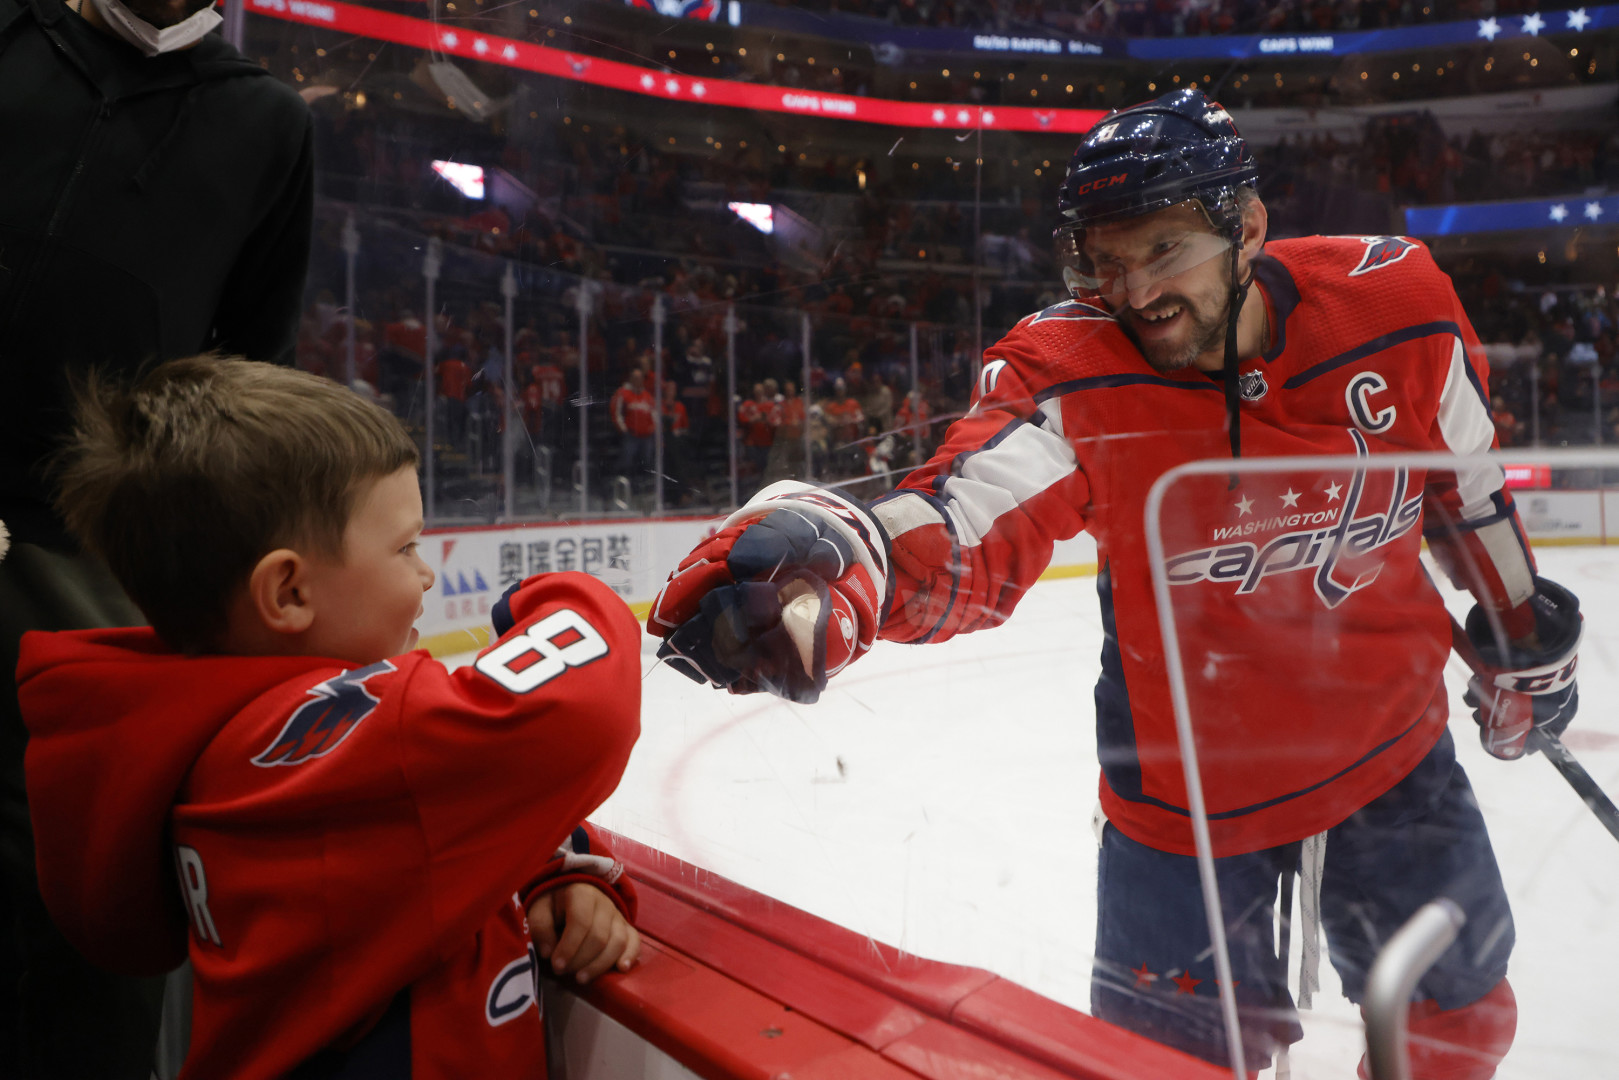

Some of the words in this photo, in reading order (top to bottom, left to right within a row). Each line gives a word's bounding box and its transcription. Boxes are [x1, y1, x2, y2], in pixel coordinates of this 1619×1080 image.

[1078, 173, 1128, 195] CCM
[1246, 377, 1260, 396] NHL
[1345, 371, 1397, 434] C
[1213, 508, 1338, 541] WASHINGTON
[474, 607, 611, 696] 8
